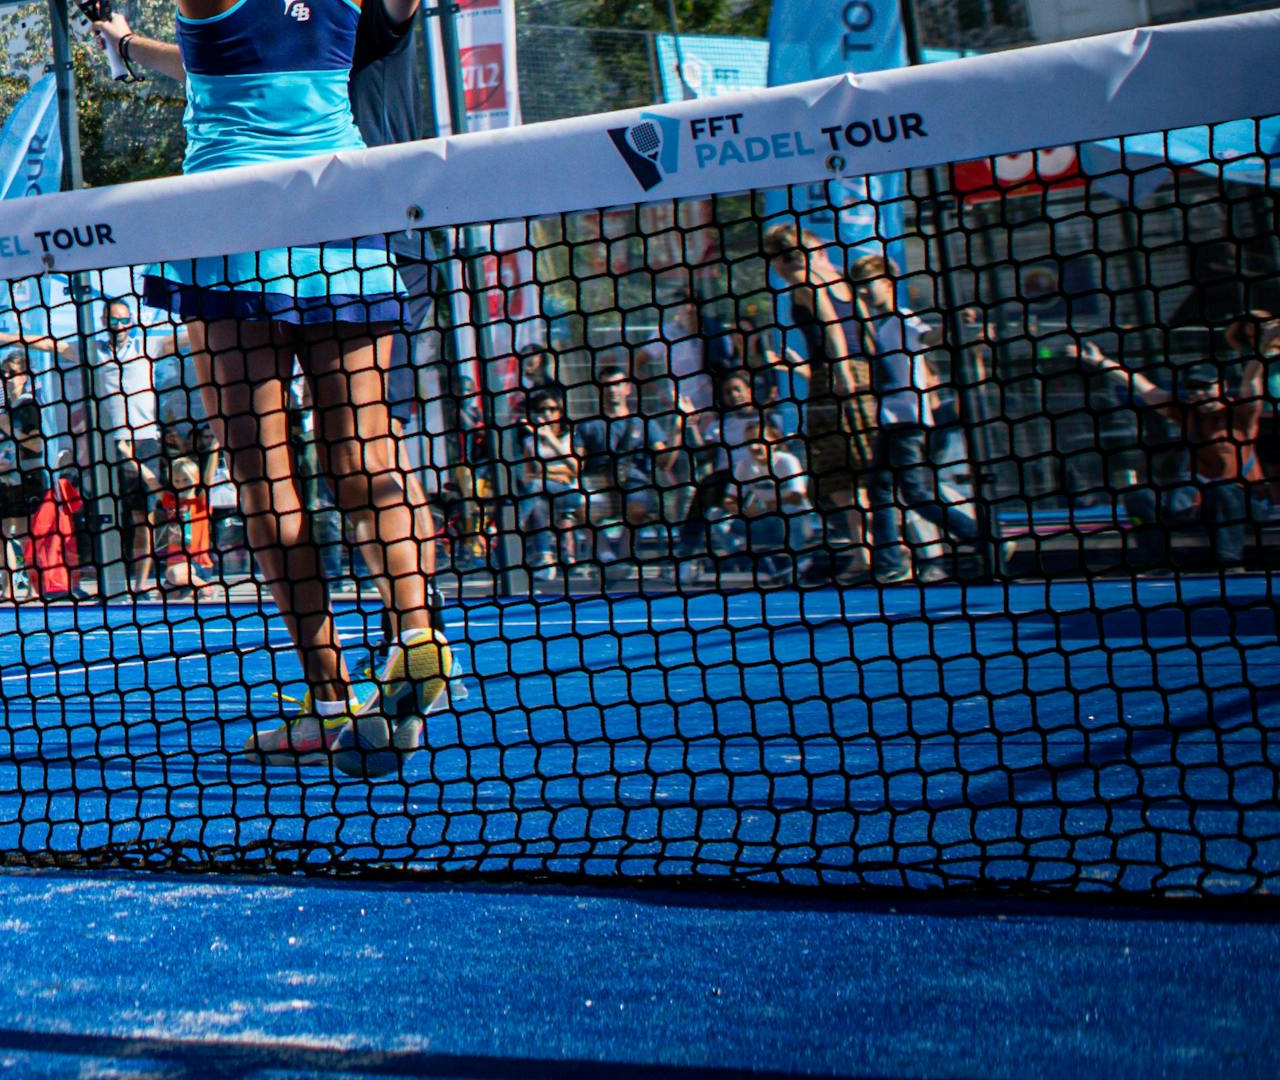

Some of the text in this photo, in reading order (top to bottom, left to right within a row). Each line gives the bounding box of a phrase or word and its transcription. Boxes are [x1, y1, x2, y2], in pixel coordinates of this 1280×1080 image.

[689, 113, 743, 140] FFT
[695, 112, 928, 168] PADEL TOUR
[25, 134, 49, 196] OUR
[34, 223, 116, 252] TOUR
